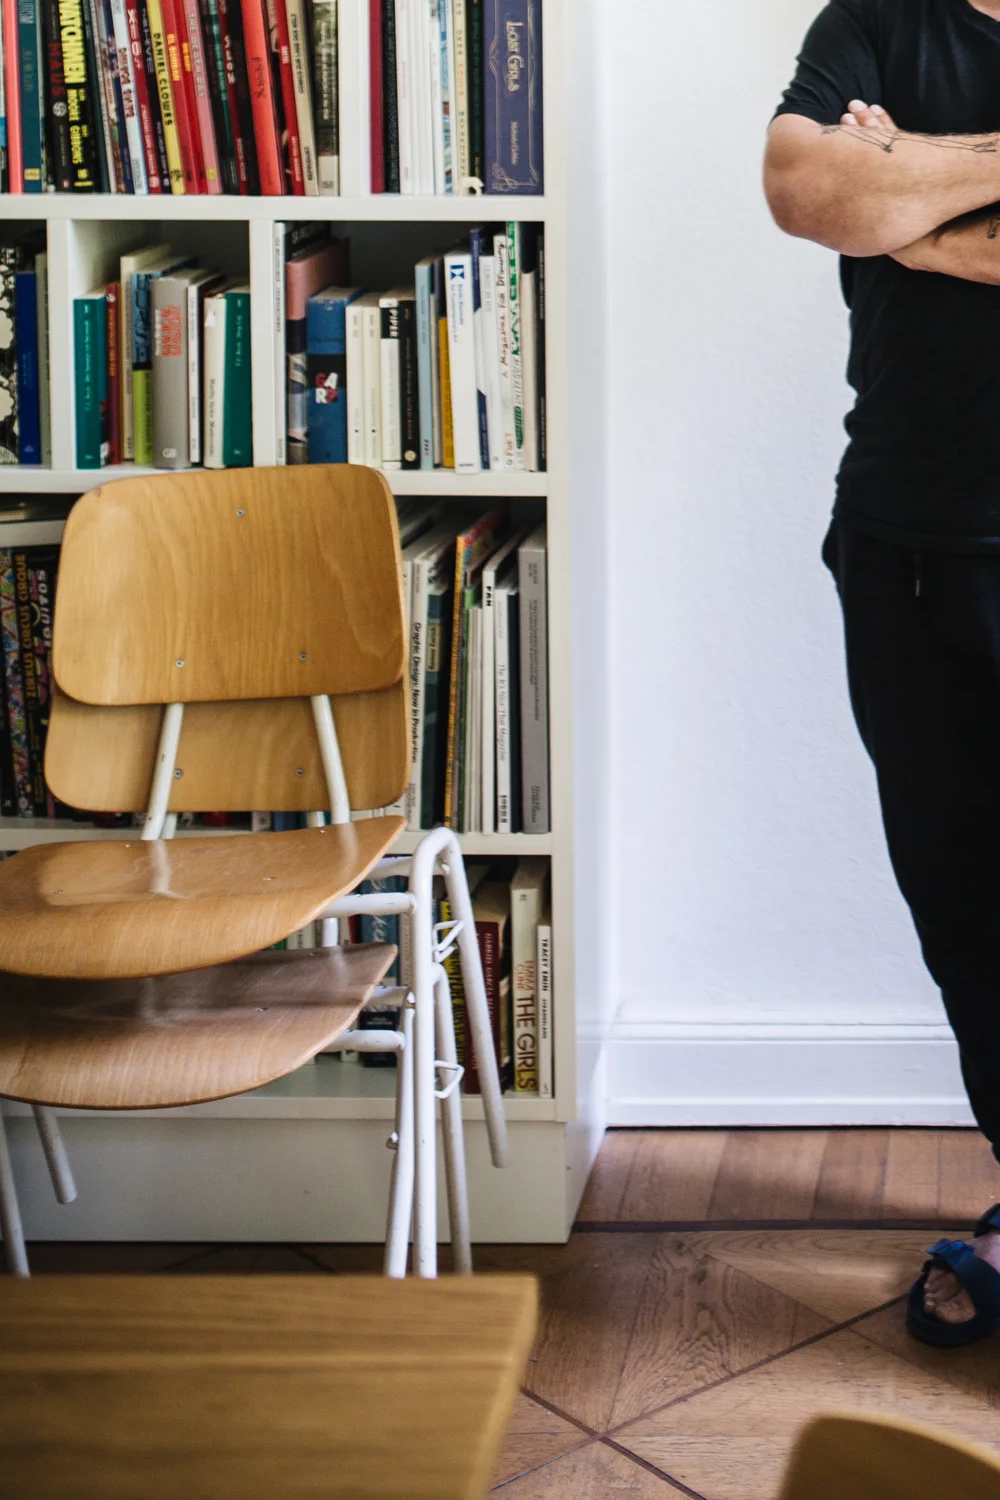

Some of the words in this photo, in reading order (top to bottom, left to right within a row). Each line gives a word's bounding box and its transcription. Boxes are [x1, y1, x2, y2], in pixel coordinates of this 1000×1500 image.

[506, 21, 524, 54] LOST
[48, 42, 65, 97] MAUS
[152, 33, 165, 73] DANIEL
[160, 79, 172, 126] CLOWES
[507, 54, 524, 92] GIRLS
[66, 89, 79, 123] MOORE
[70, 125, 83, 165] GIBBONS
[389, 308, 399, 338] PIPER
[15, 553, 29, 601] CIRQUE
[19, 605, 33, 649] CIRCUS
[411, 621, 422, 654] Graphic
[22, 652, 37, 698] ZIRKUS
[412, 689, 420, 708] Now
[412, 708, 419, 716] in
[484, 932, 494, 965] GABRIEL
[541, 937, 549, 968] TRACEY
[524, 960, 535, 992] EMMA
[541, 970, 549, 992] EMIN
[516, 994, 535, 1028] THE
[516, 1033, 536, 1090] GIRLS
